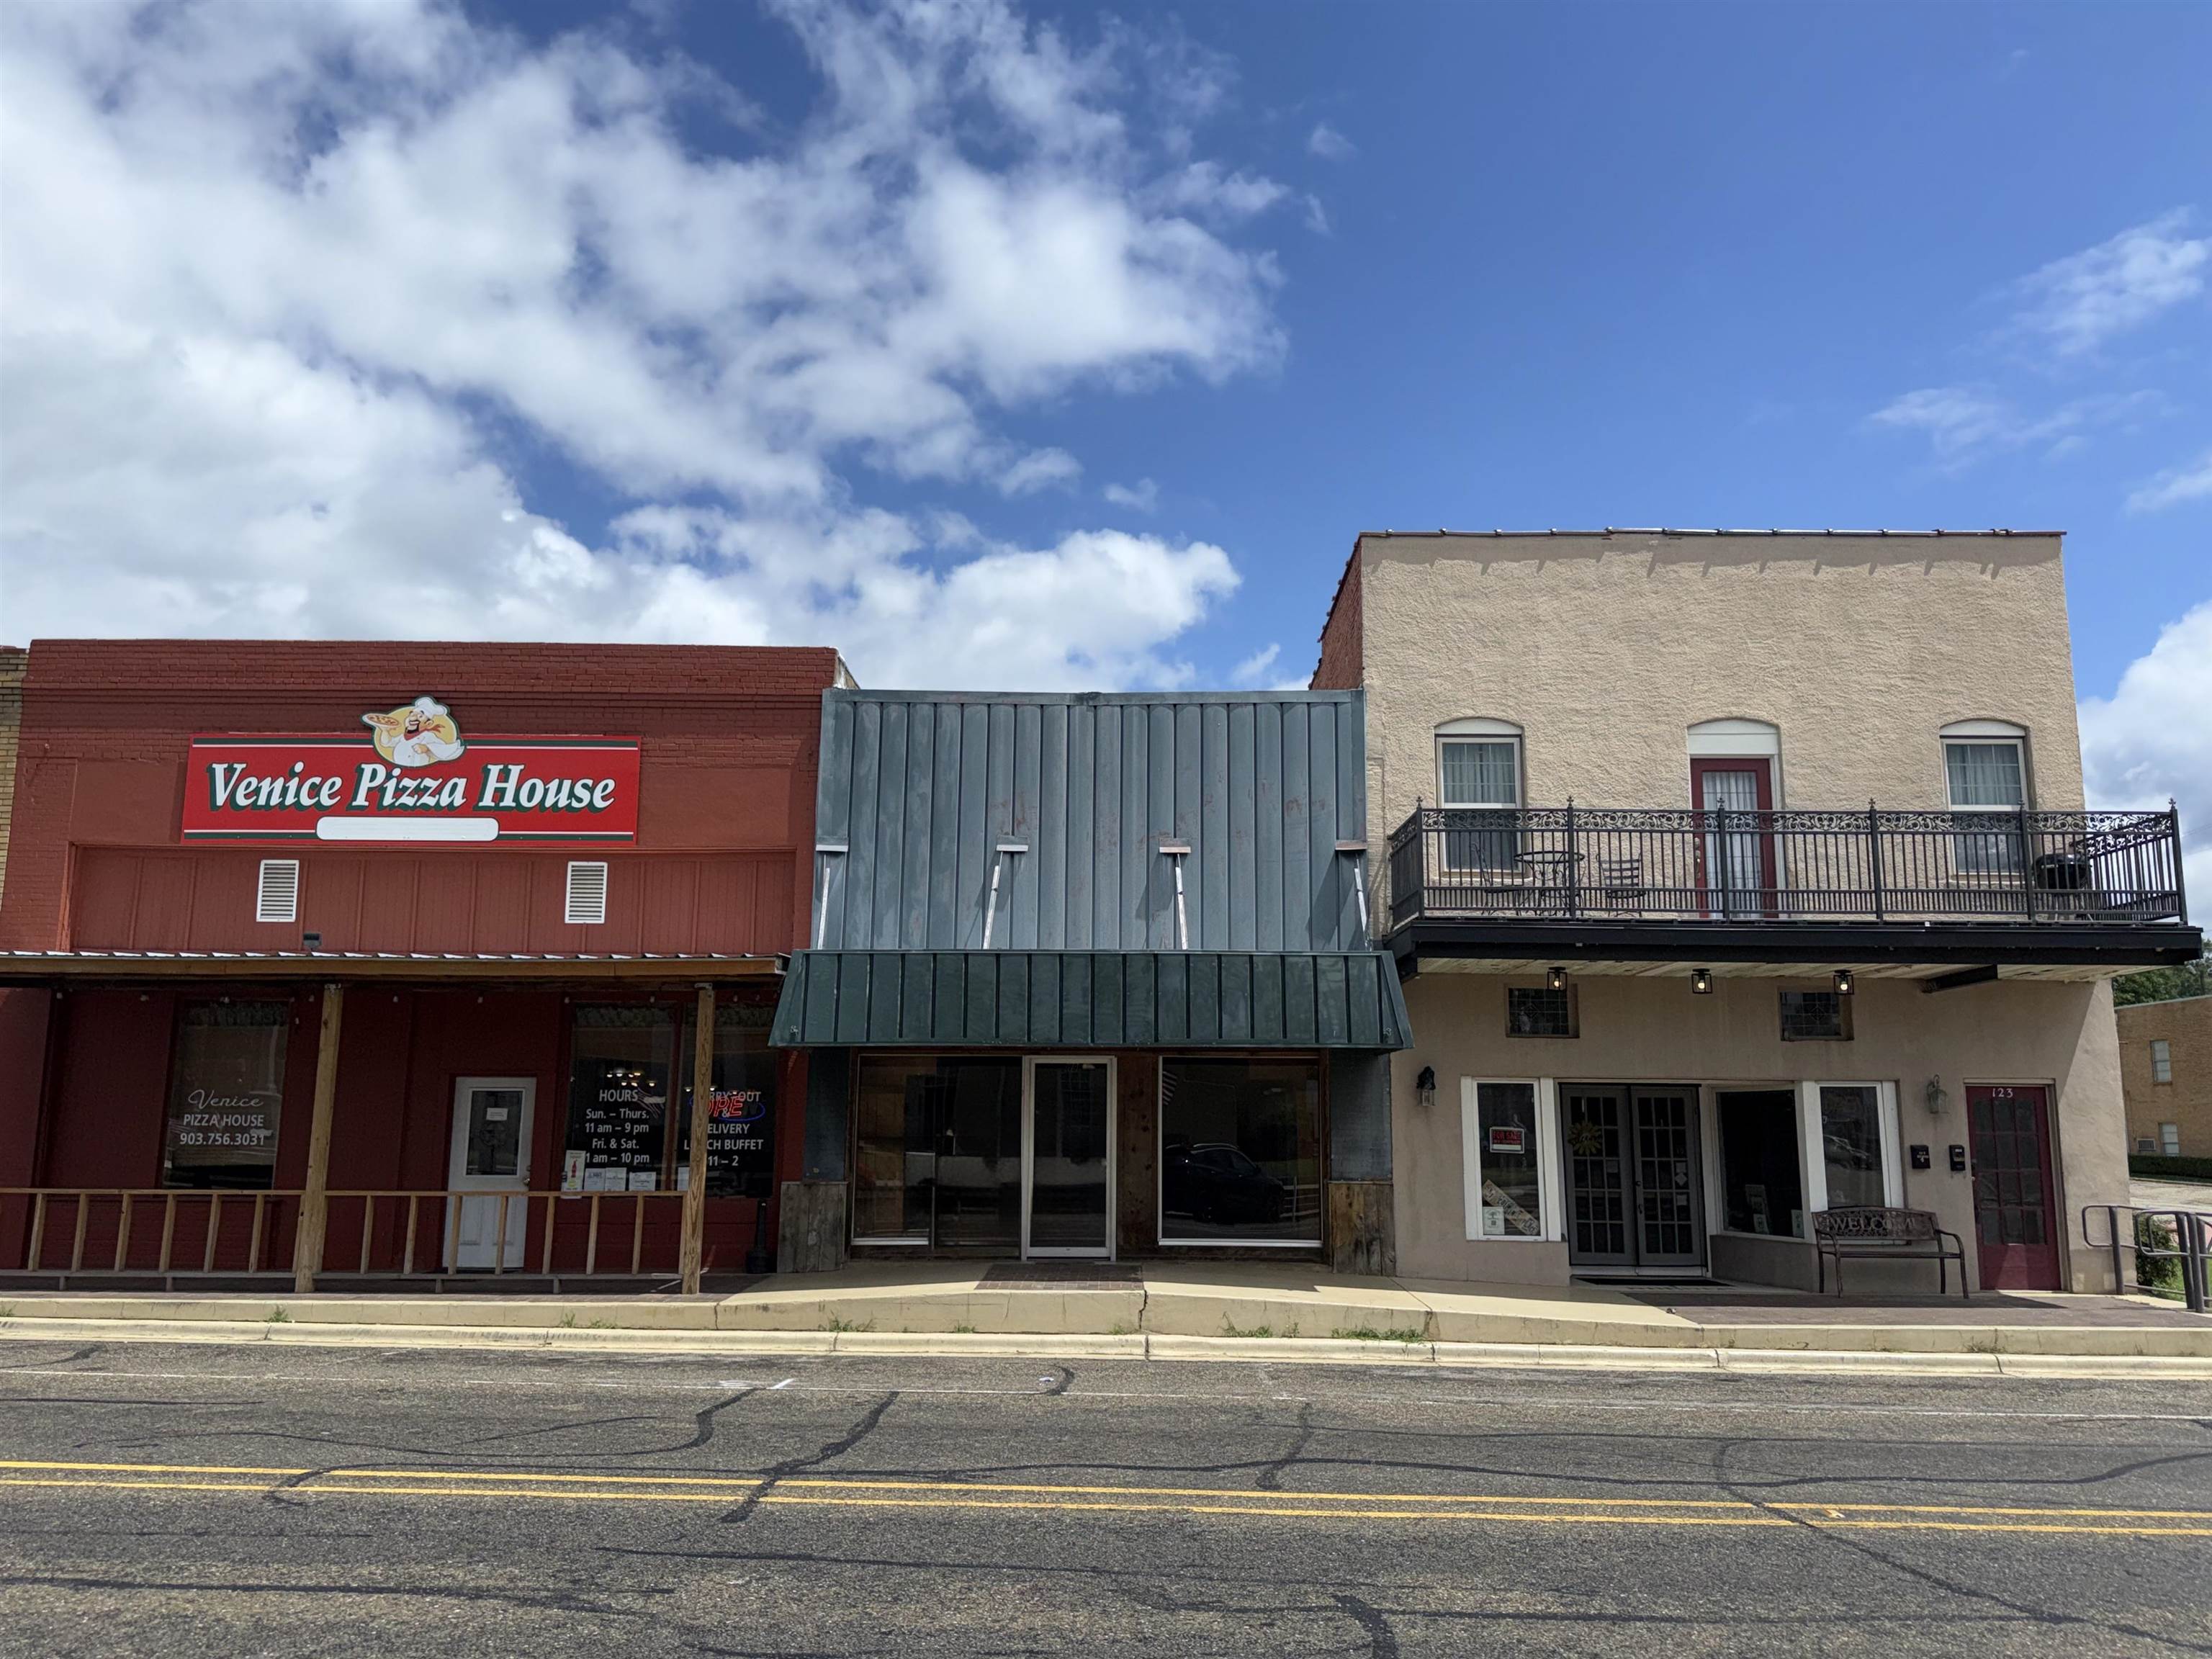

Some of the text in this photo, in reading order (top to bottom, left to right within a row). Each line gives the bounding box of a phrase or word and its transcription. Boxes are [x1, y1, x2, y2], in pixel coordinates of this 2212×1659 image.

[210, 760, 616, 813] Venice Pizza House
[599, 1089, 639, 1102] HOURS
[1992, 1088, 2013, 1097] 123
[188, 1089, 264, 1110] Venice
[586, 1108, 607, 1119] Sun.
[619, 1108, 649, 1119] Thurs.
[183, 1114, 264, 1127] PIZZA HOUSE
[585, 1122, 595, 1133] 11
[625, 1122, 631, 1133] 9
[634, 1125, 649, 1136] pm
[708, 1124, 750, 1134] ELIVERY
[180, 1133, 264, 1146] 903.756.3031
[592, 1138, 639, 1149] Fri. & Sat.
[684, 1139, 764, 1150] LCH BUFFET
[621, 1153, 631, 1163] 10
[634, 1155, 649, 1165] pm
[732, 1156, 739, 1166] 2
